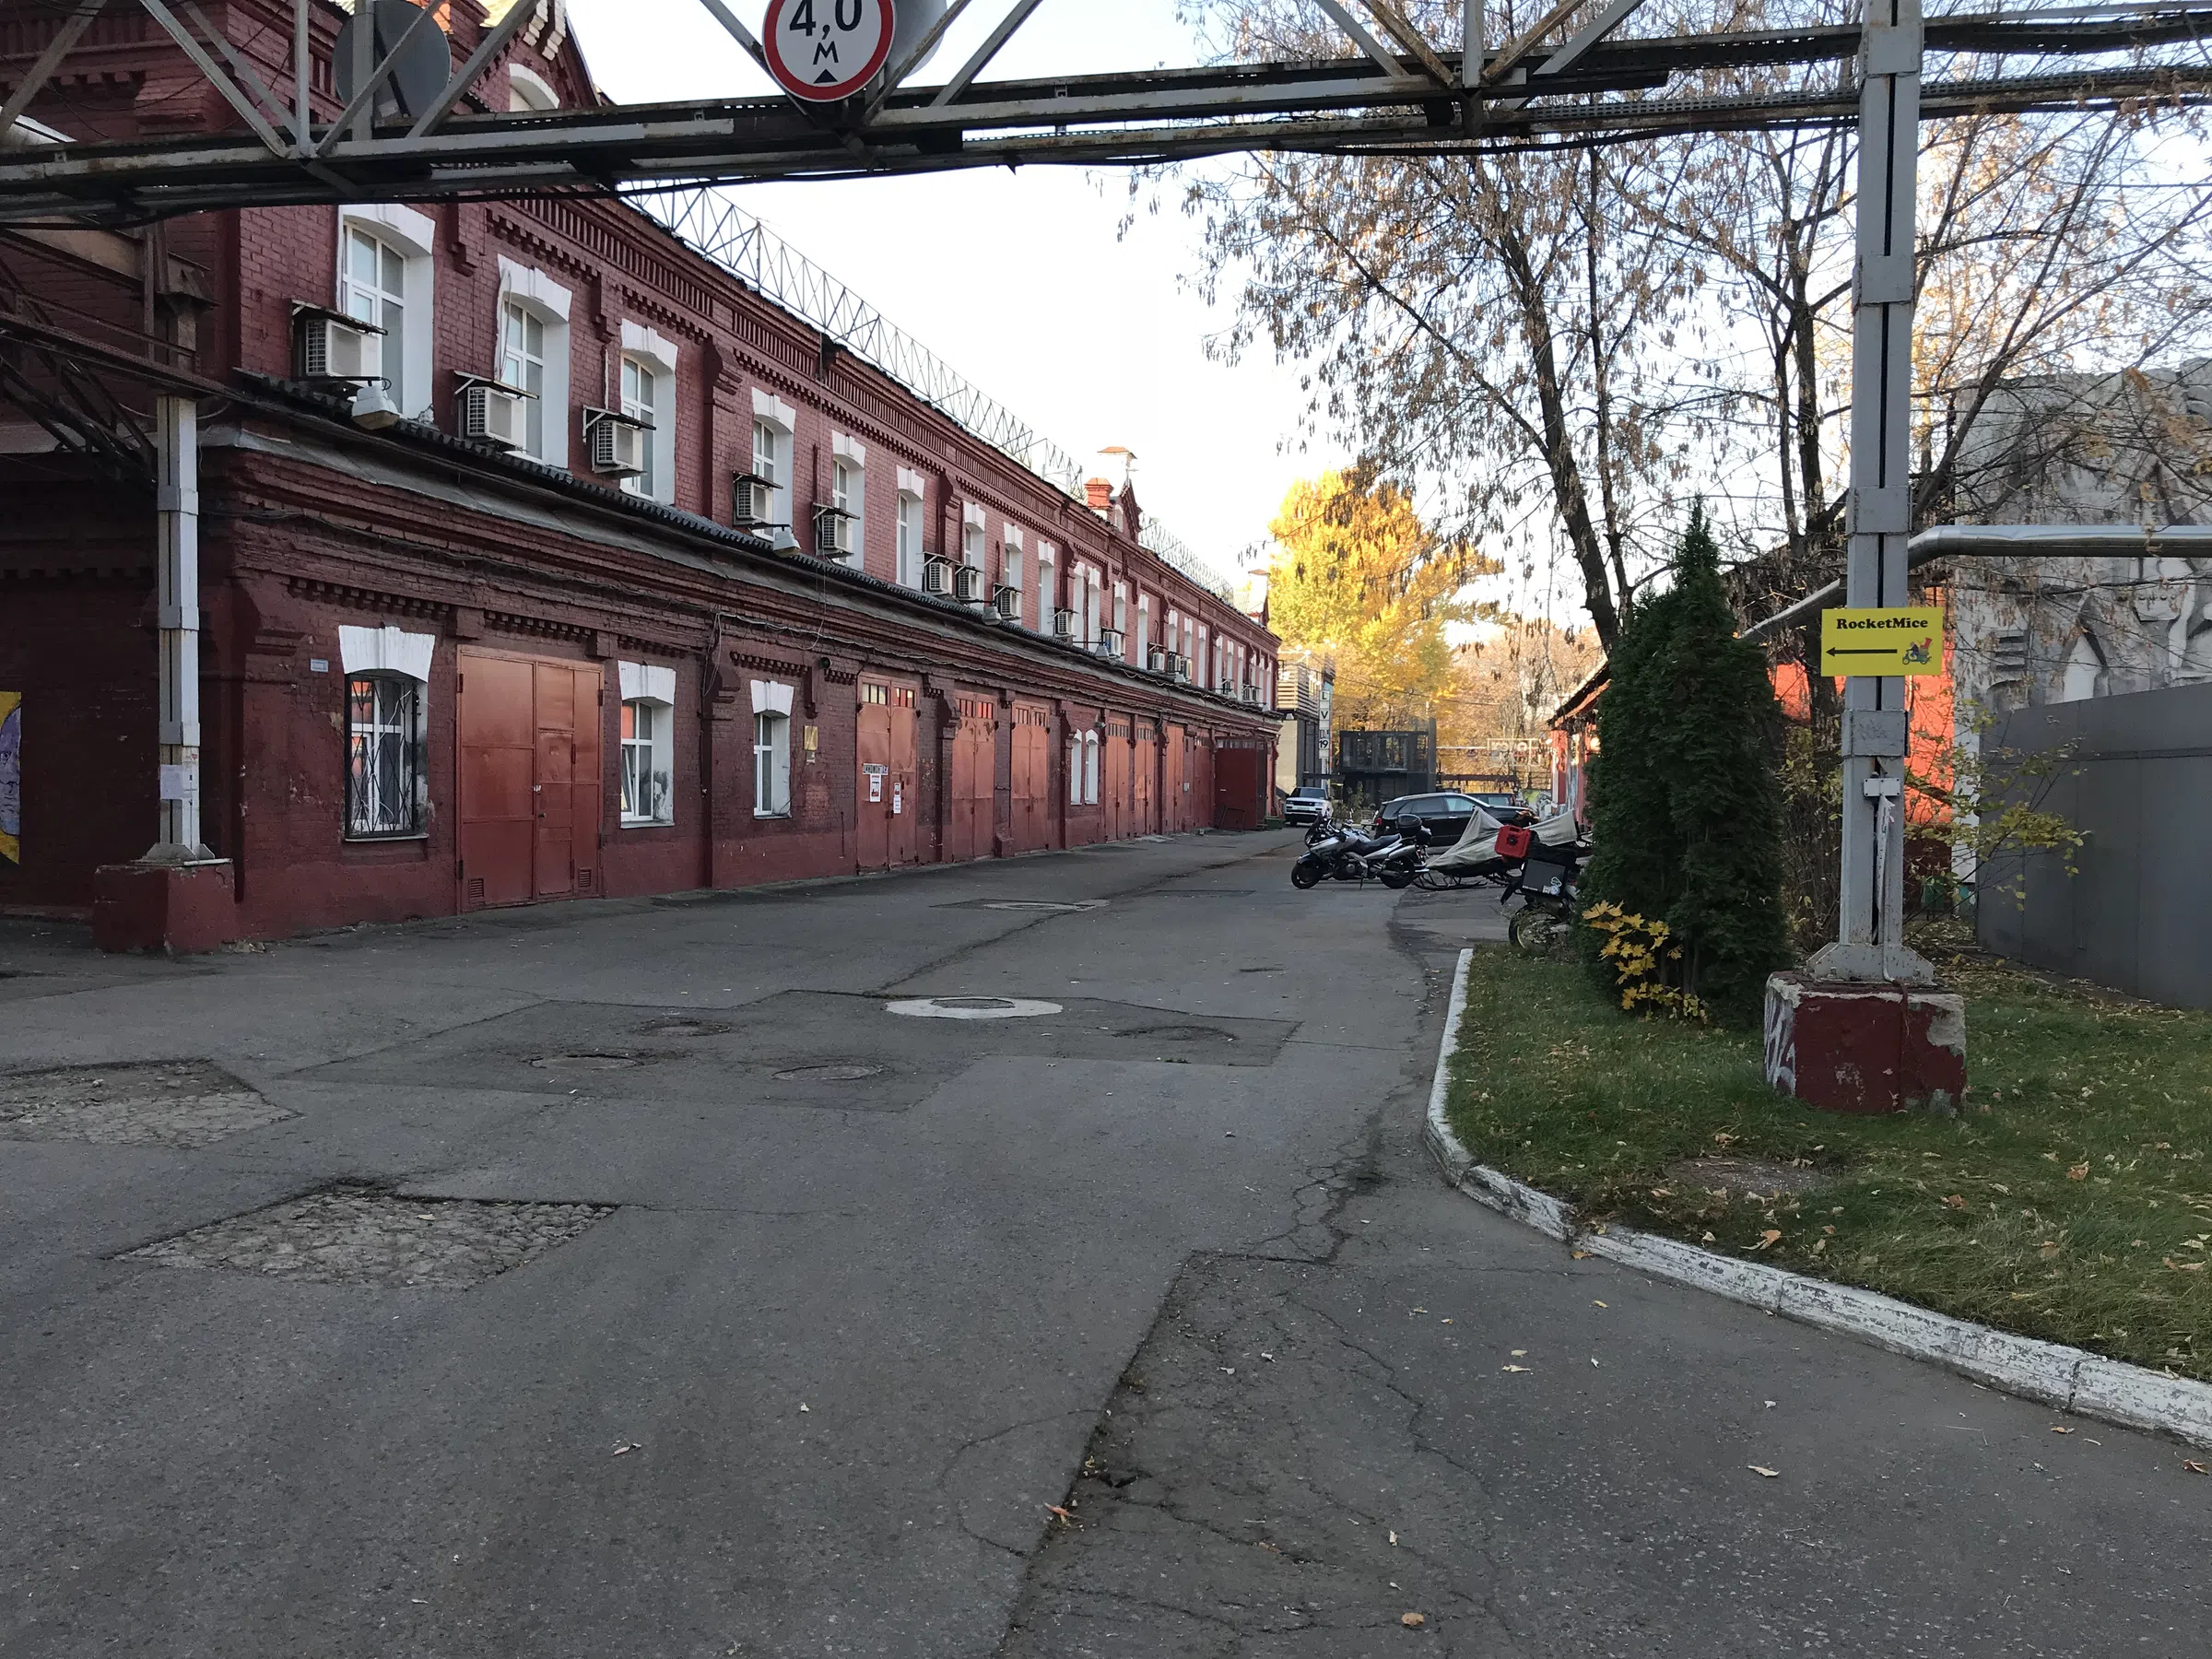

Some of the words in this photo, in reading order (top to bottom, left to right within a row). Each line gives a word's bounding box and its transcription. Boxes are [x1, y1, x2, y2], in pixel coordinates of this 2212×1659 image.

[789, 0, 863, 40] 4,0
[1836, 618, 1928, 629] RocketMice
[1319, 740, 1329, 748] 19
